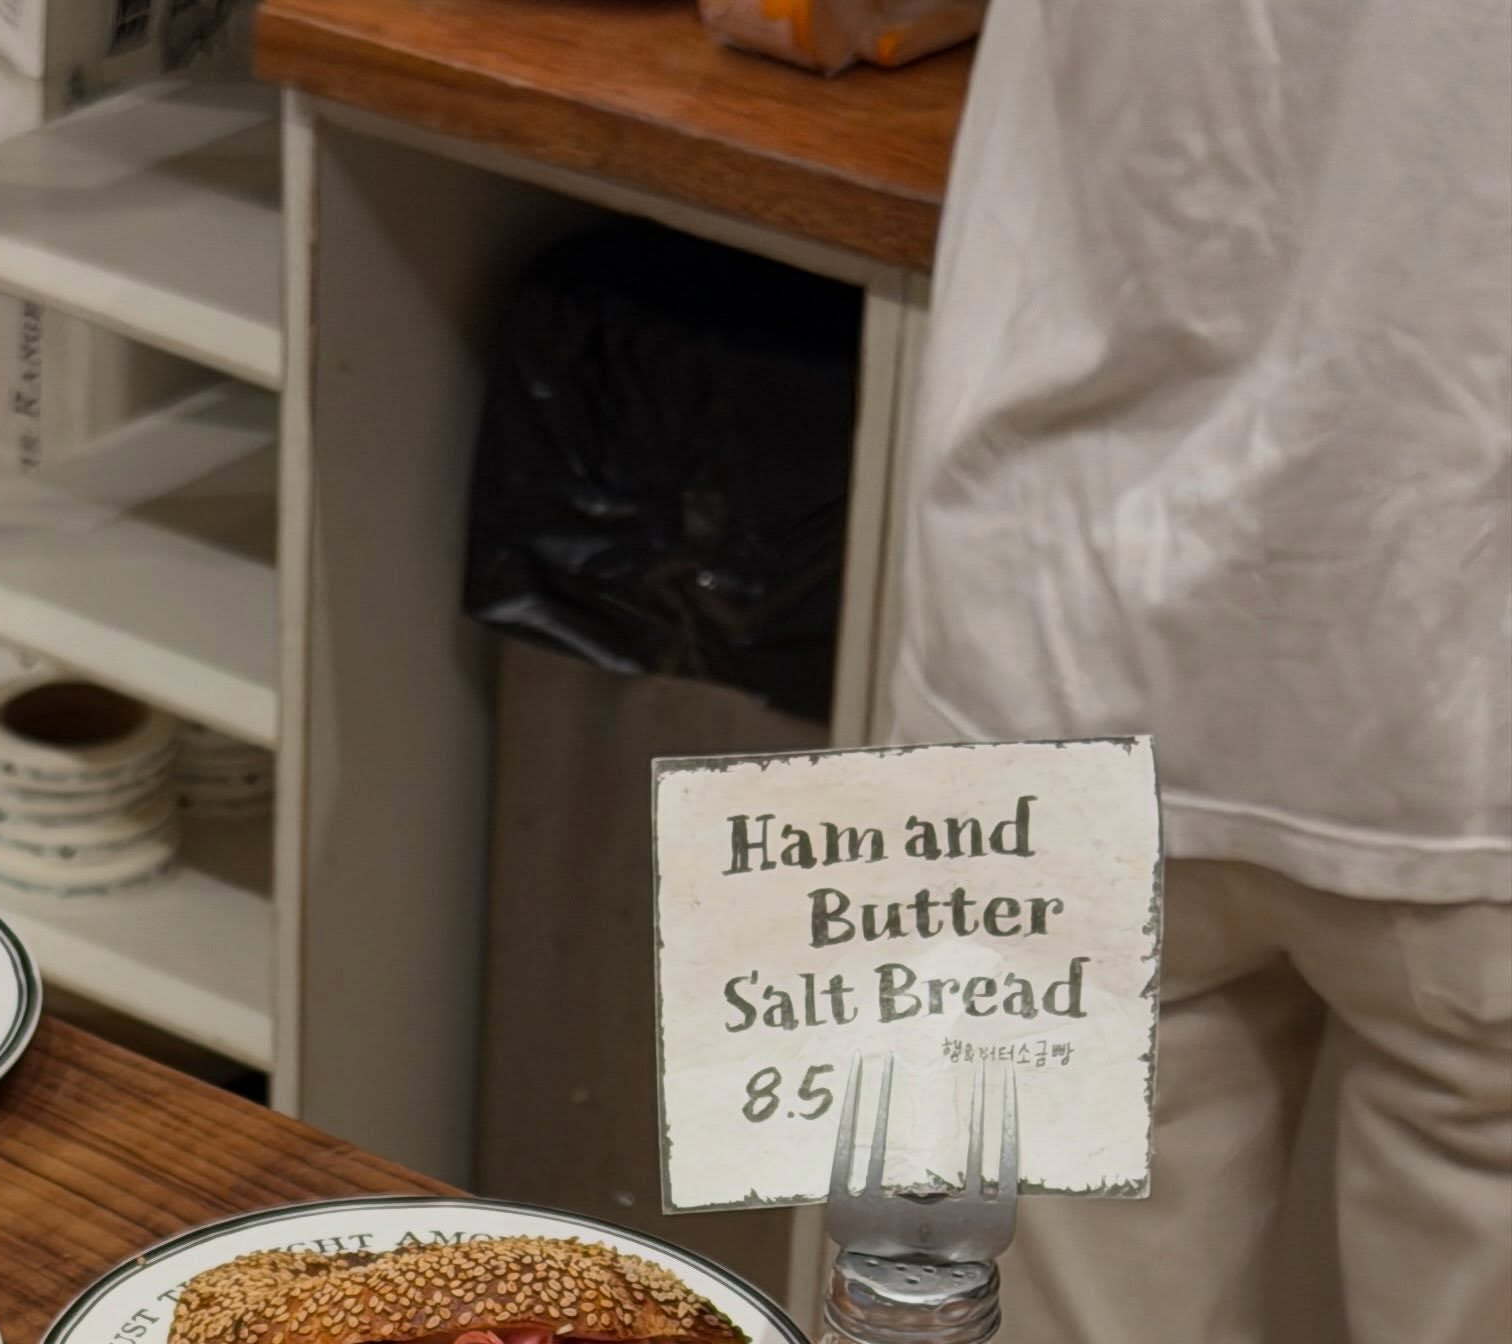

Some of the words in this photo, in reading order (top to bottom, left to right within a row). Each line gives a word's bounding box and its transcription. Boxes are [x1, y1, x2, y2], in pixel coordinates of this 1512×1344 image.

[721, 813, 888, 876] Ham
[904, 795, 1039, 861] and
[808, 886, 1065, 949] Butter
[722, 970, 858, 1034] Salt
[873, 956, 1091, 1024] Bread
[741, 1063, 835, 1124] 8.5
